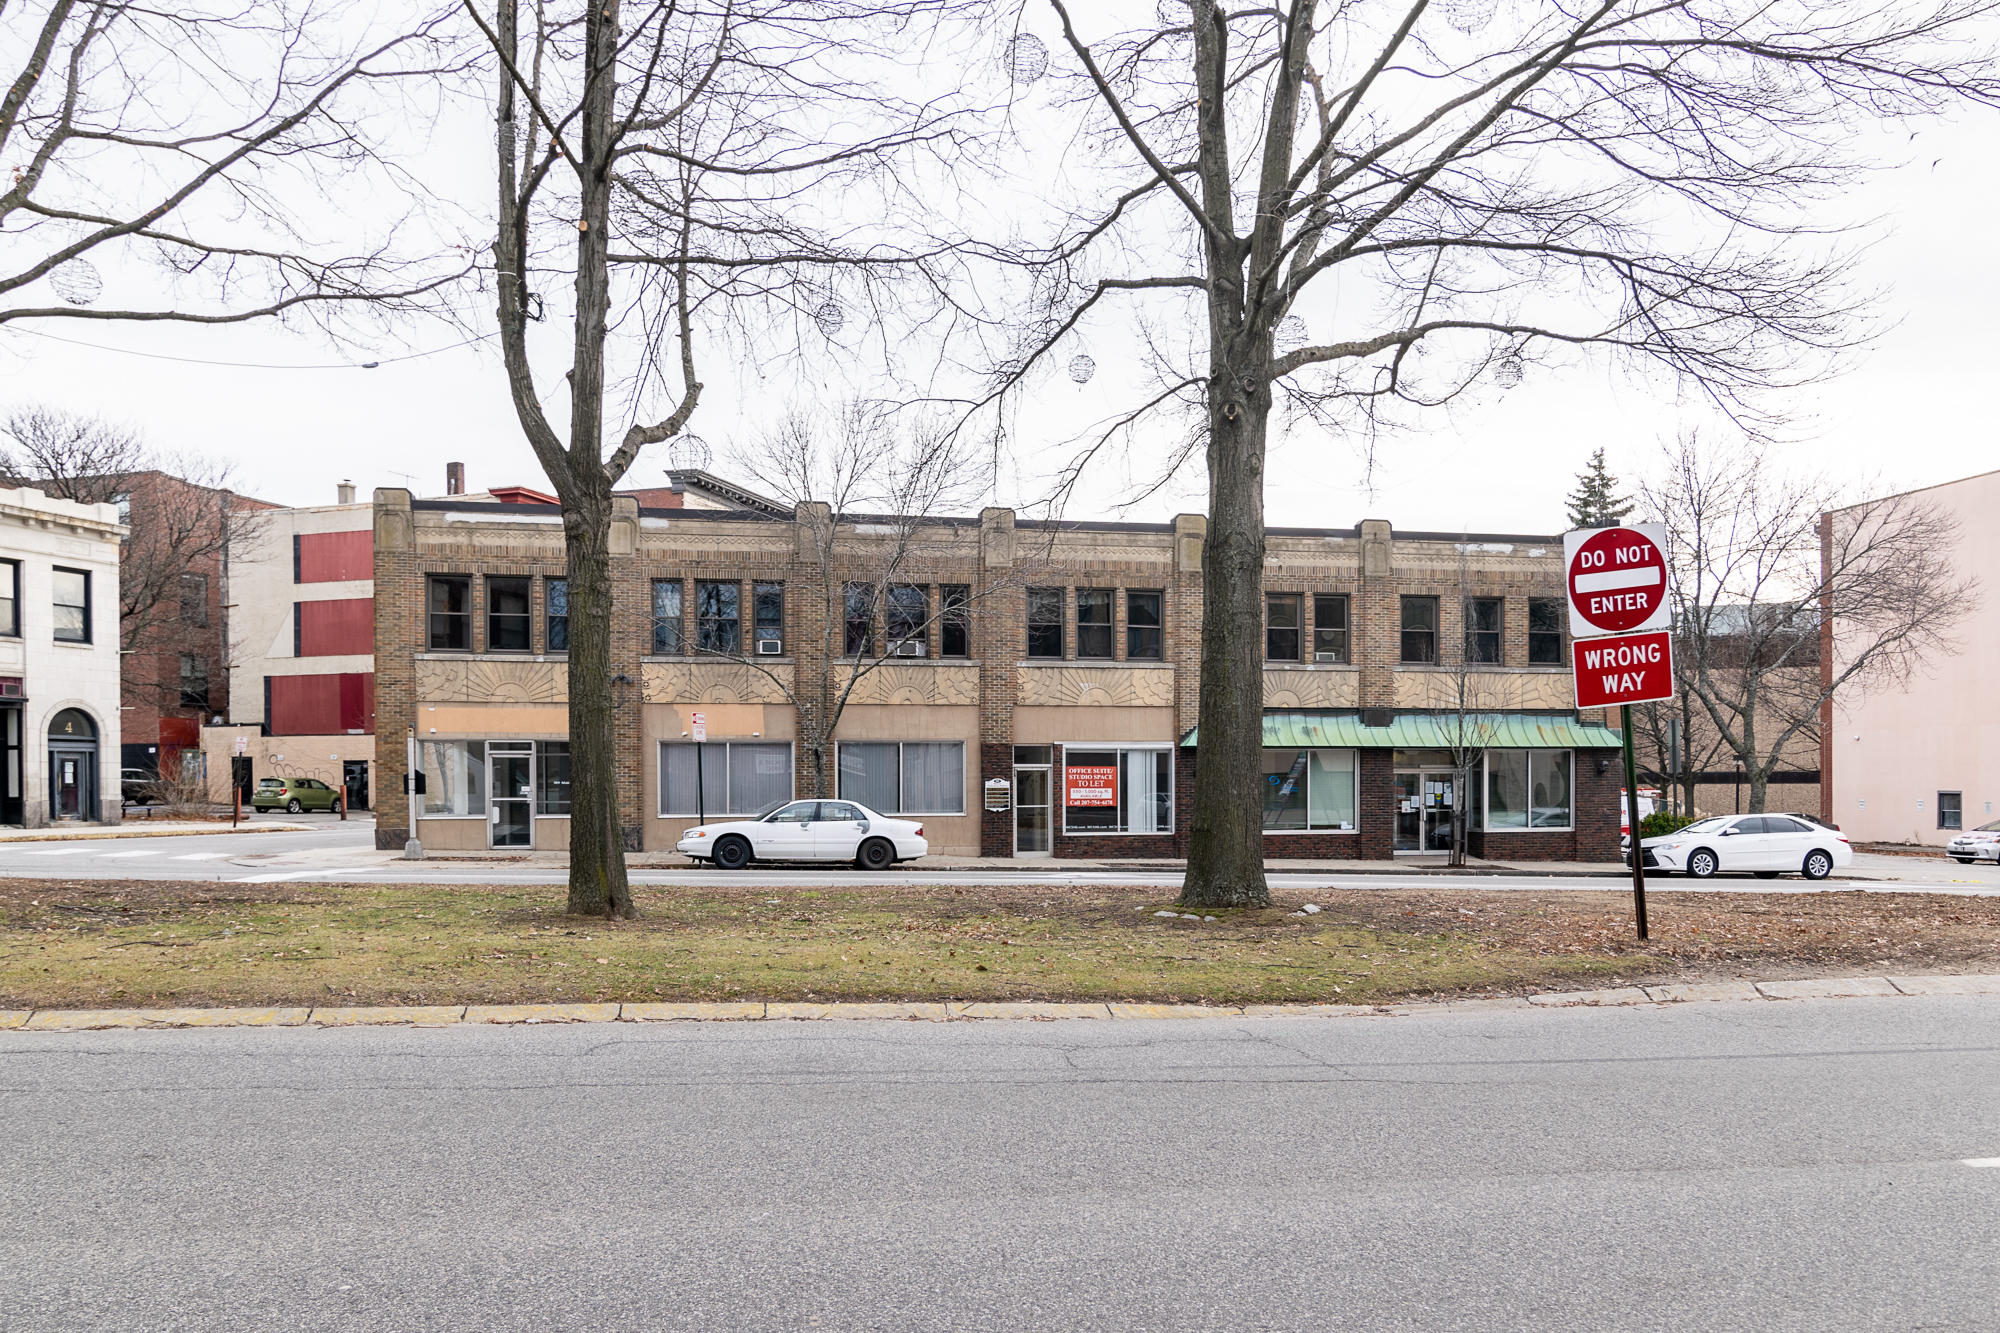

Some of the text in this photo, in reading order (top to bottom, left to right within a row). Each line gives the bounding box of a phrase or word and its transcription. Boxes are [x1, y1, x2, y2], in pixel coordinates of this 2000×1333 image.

[1580, 544, 1651, 568] DO NOT
[1590, 592, 1648, 615] ENTER
[1584, 643, 1661, 670] WRONG
[1602, 671, 1646, 694] WAY
[65, 721, 73, 733] 4
